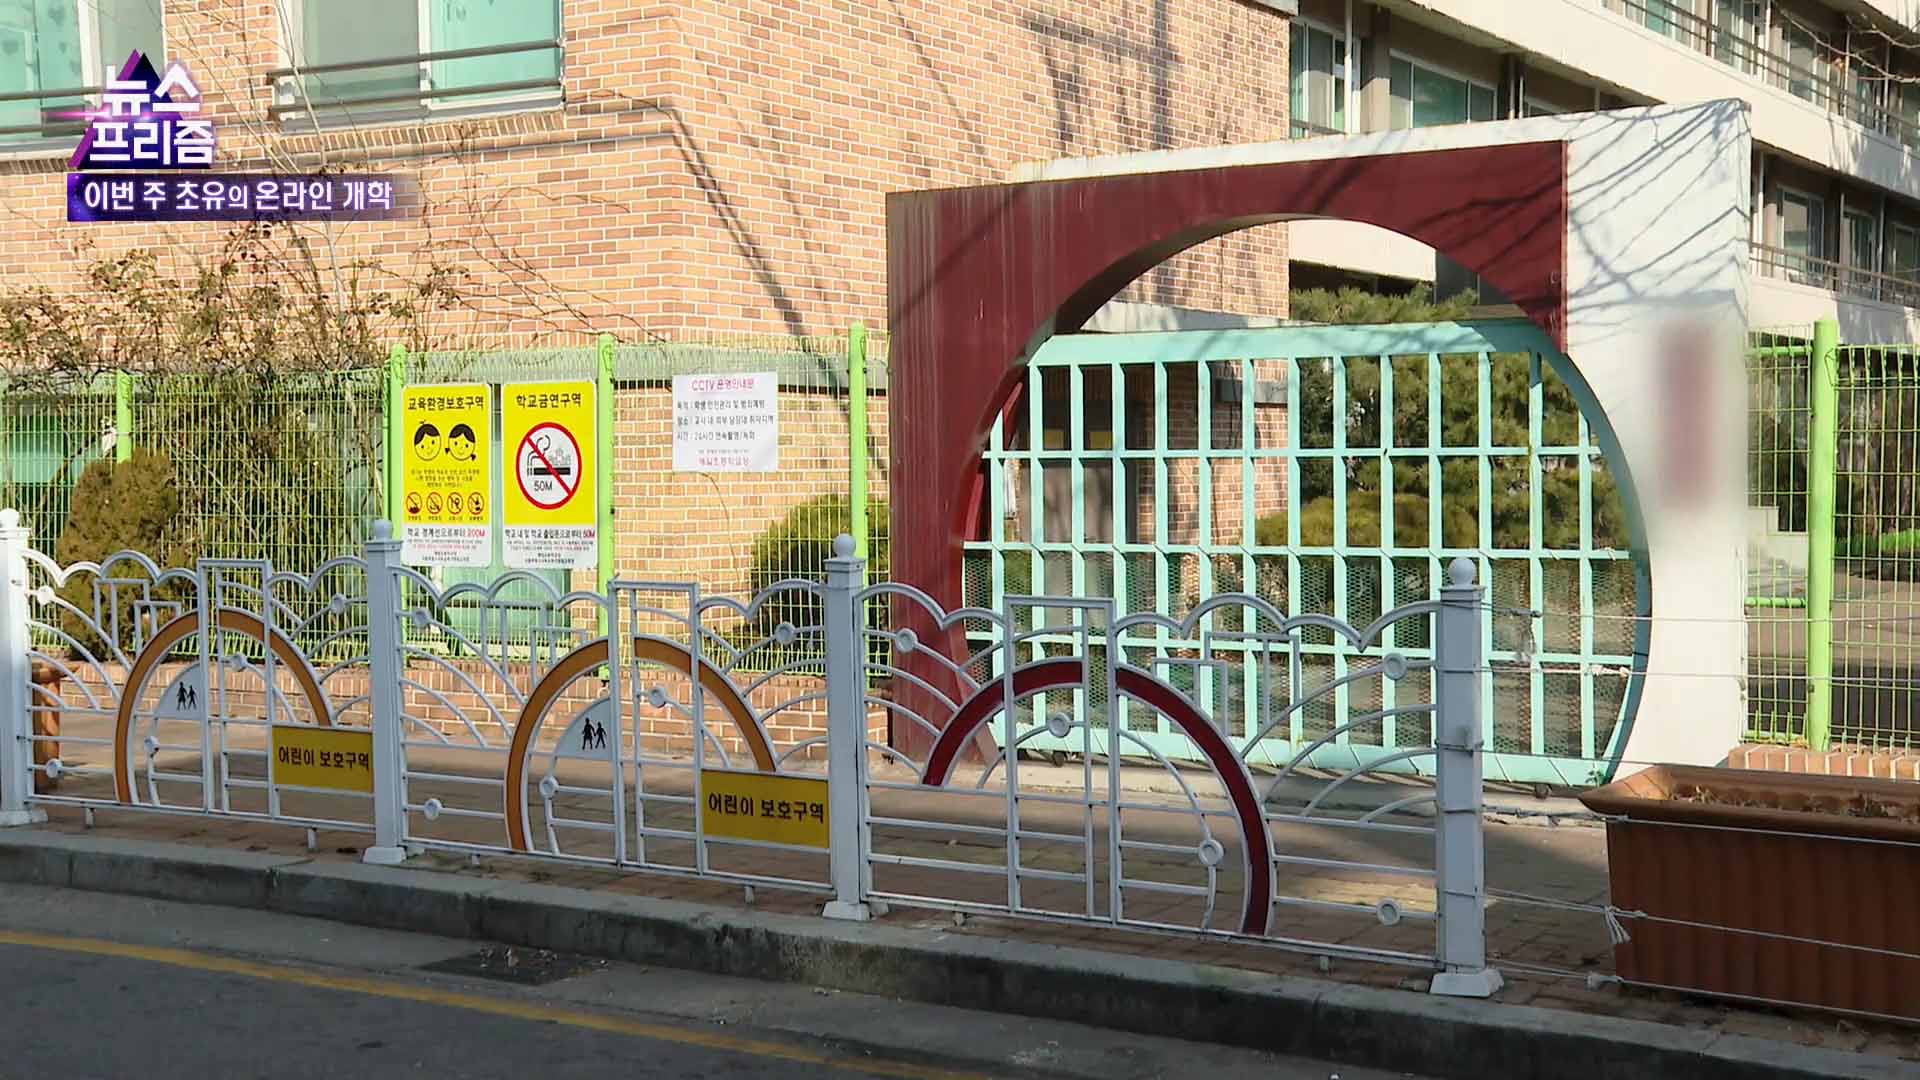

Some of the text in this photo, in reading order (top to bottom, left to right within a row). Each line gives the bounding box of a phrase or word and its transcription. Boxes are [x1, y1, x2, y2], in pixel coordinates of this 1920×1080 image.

[691, 379, 715, 391] CCTV
[407, 395, 484, 411] 교육환경보호구역
[515, 392, 581, 408] 학교금연구역
[694, 400, 706, 410] 학생
[694, 432, 714, 441] 24시간
[534, 480, 553, 492] 50M
[407, 527, 419, 537] 학교
[505, 528, 516, 538] 학교
[531, 528, 542, 538] 학교
[583, 529, 596, 538] 50M
[278, 746, 370, 771] 어린이 보호구역
[708, 792, 824, 824] 어린이 보호구역
